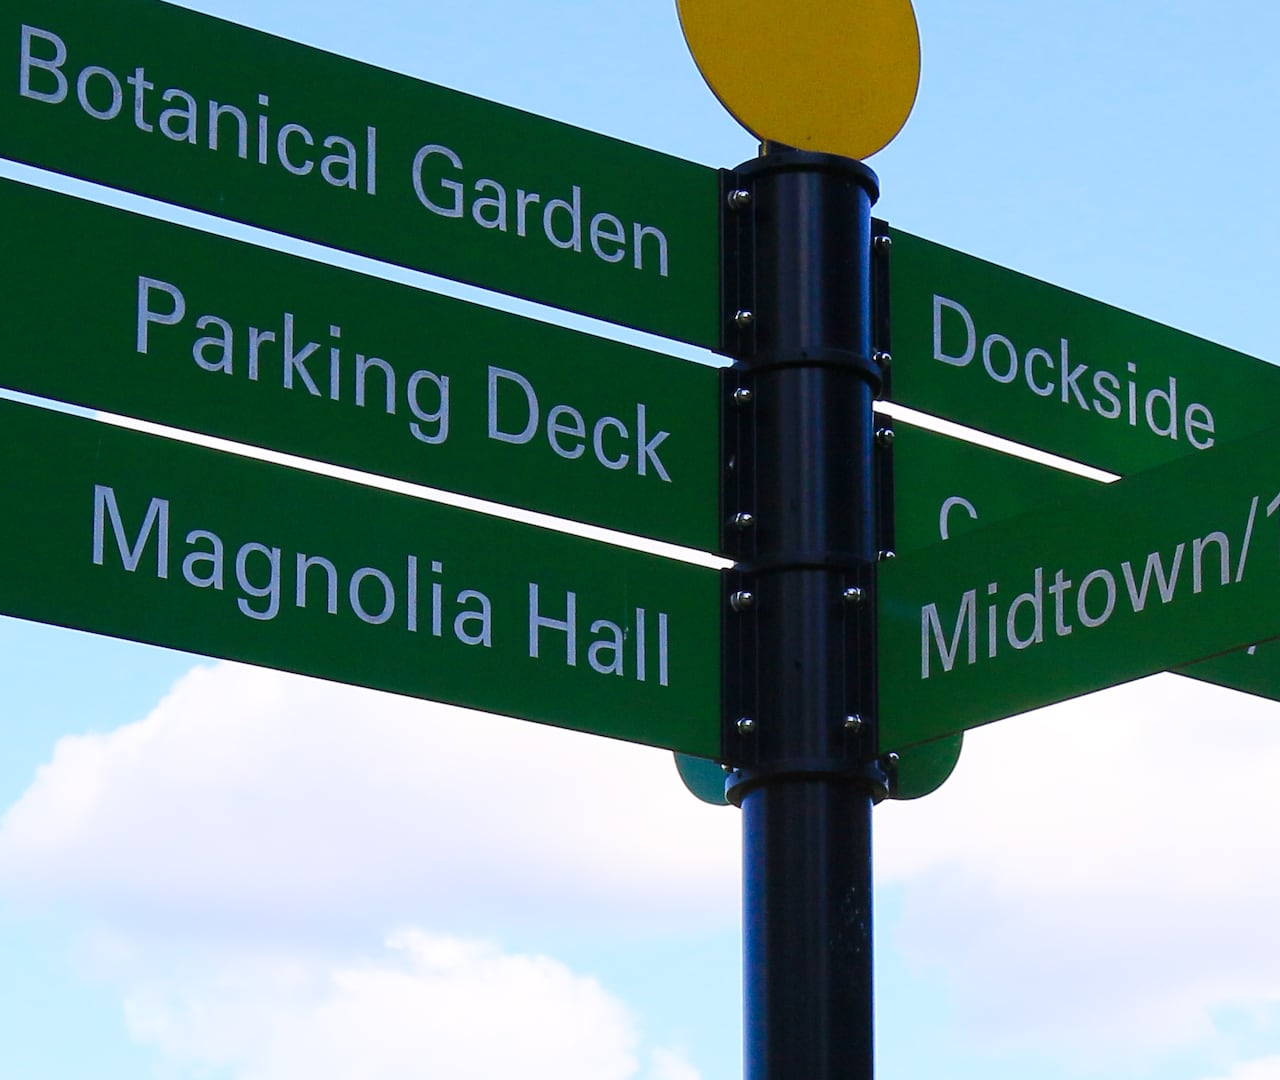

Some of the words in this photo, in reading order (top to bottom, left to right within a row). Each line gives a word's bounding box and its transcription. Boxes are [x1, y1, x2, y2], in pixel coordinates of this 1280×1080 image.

[19, 23, 377, 196] Botanical
[411, 143, 670, 278] Garden
[136, 274, 451, 446] Parking
[487, 364, 673, 484] Deck
[932, 293, 1216, 450] Dockside
[91, 483, 493, 649] Magnolia
[528, 581, 670, 688] Hall
